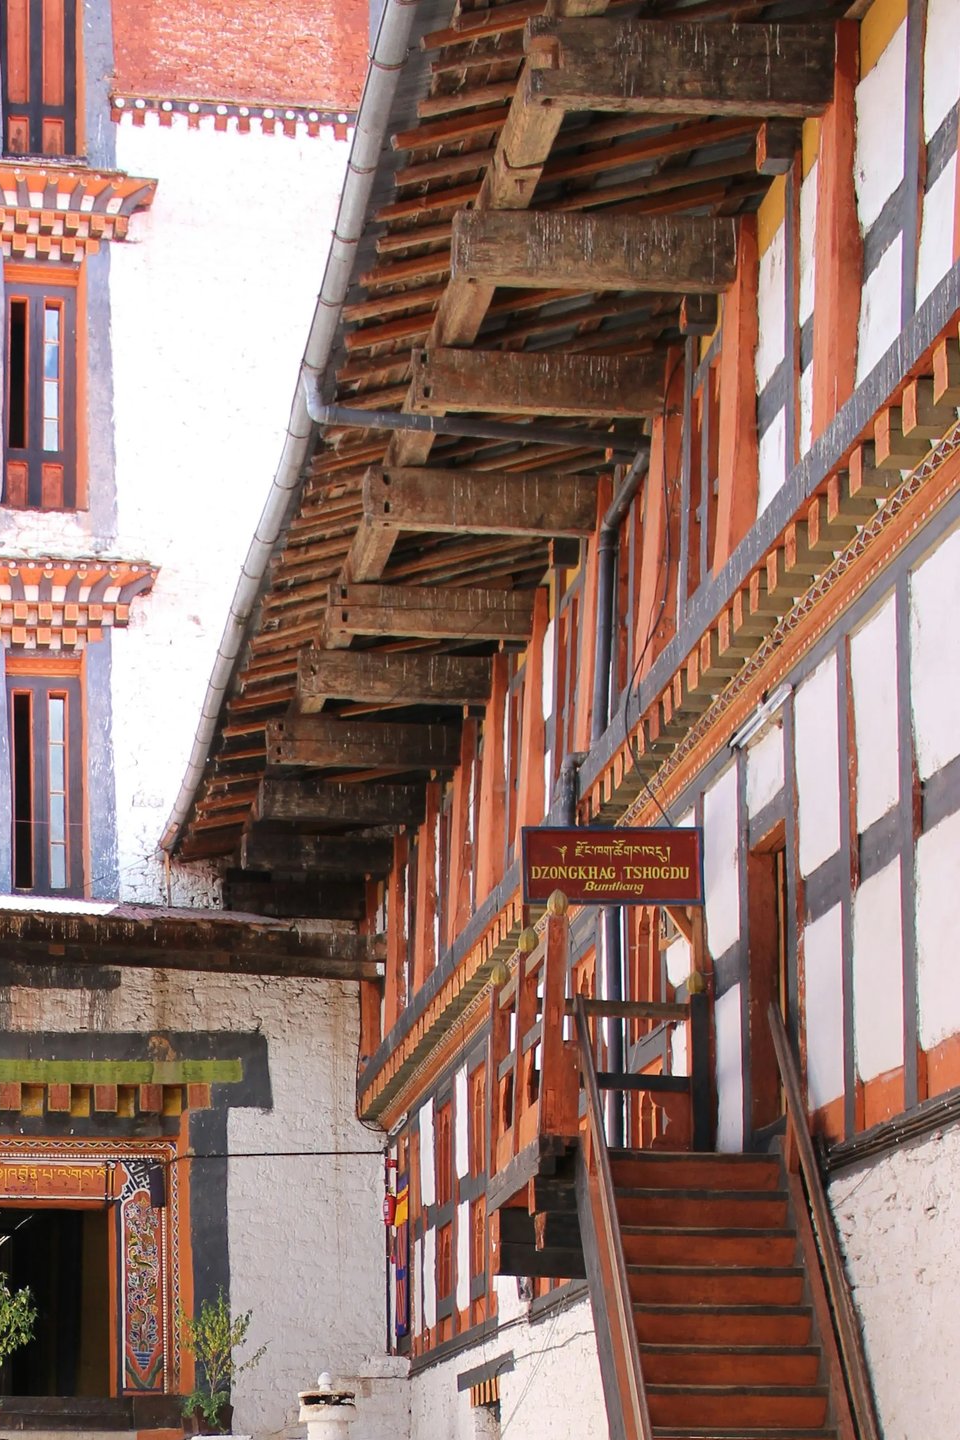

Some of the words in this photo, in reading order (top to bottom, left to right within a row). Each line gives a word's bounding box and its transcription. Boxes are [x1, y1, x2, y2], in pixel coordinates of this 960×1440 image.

[531, 866, 616, 879] DZONGKHAG
[623, 866, 690, 879] TSHOGDU
[583, 881, 645, 894] Bumthang
